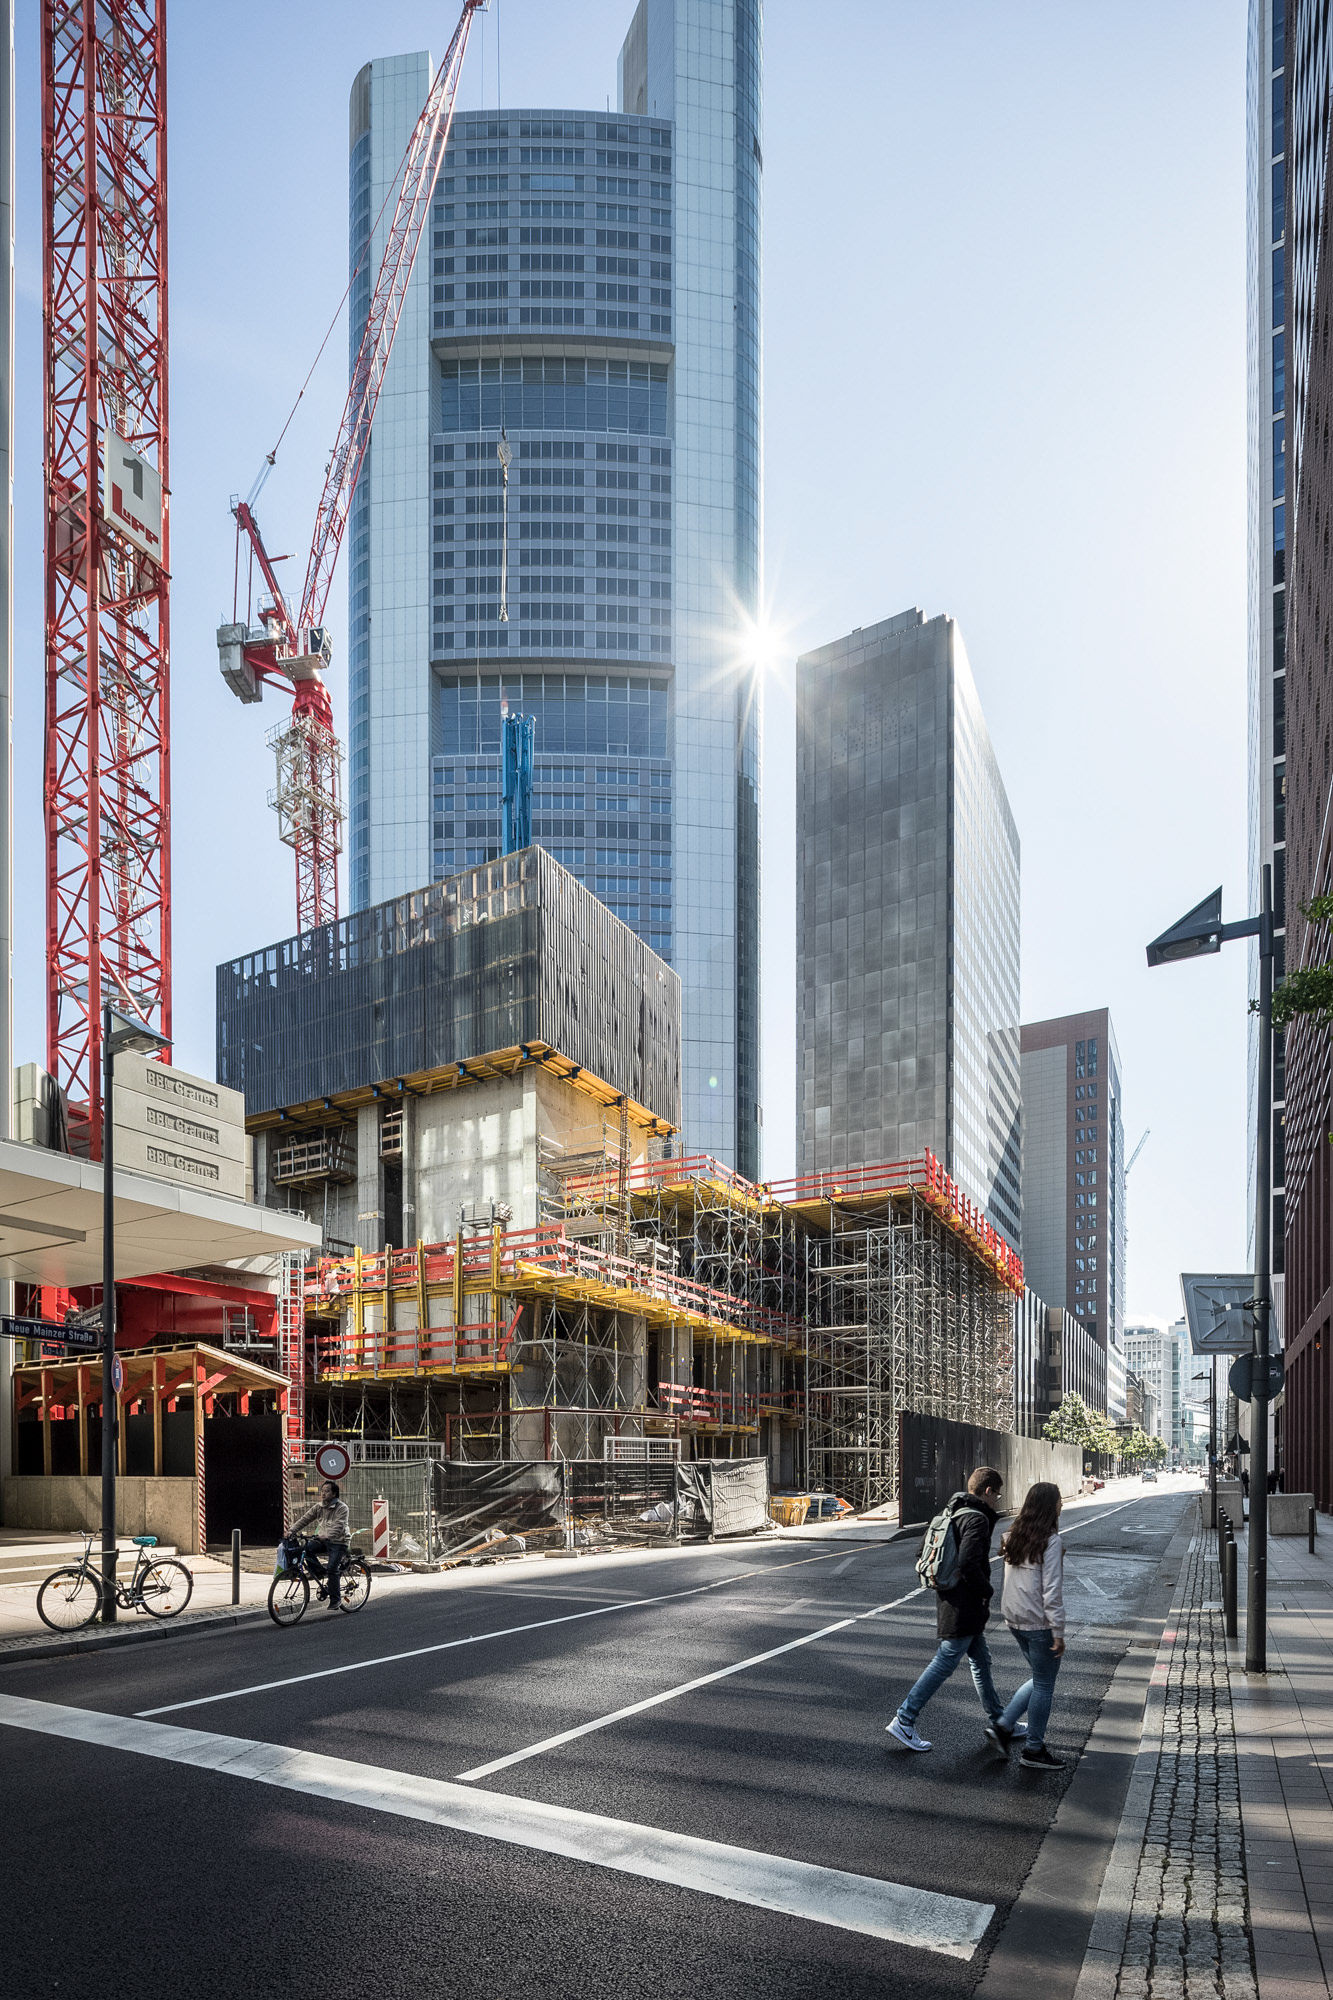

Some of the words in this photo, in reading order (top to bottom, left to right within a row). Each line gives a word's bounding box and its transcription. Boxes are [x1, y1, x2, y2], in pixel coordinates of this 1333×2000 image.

[147, 1071, 173, 1092] BBL
[175, 1081, 217, 1107] Cranes
[147, 1109, 173, 1130] BBL
[175, 1119, 218, 1144] Cranes
[148, 1148, 173, 1168] BBL
[175, 1156, 218, 1180] Cranes
[9, 1321, 30, 1334] Neue
[33, 1325, 66, 1339] Mainzer
[68, 1330, 93, 1342] Straße
